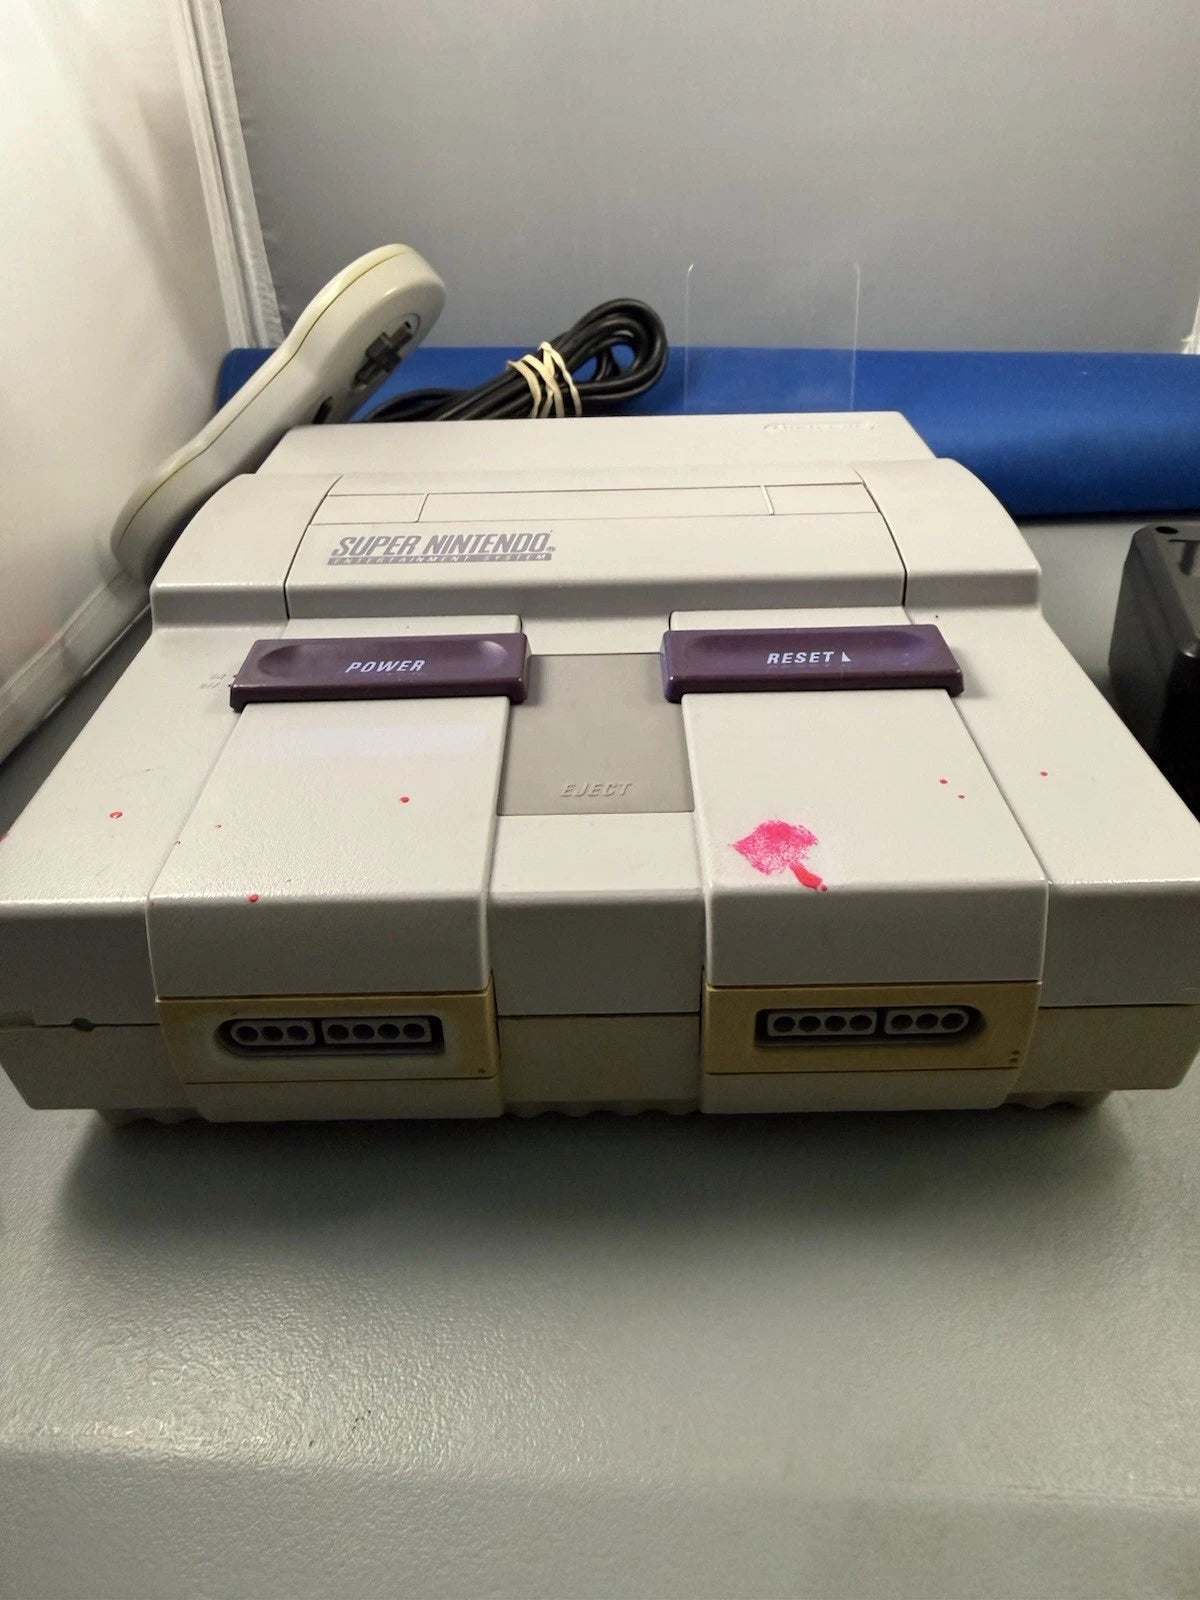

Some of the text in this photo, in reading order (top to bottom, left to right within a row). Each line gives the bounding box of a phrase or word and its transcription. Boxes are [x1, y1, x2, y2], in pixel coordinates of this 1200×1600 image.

[331, 532, 552, 556] SUPER NINTENDO
[766, 651, 834, 664] RESET
[345, 660, 425, 673] POWER
[561, 783, 632, 798] EJECT
